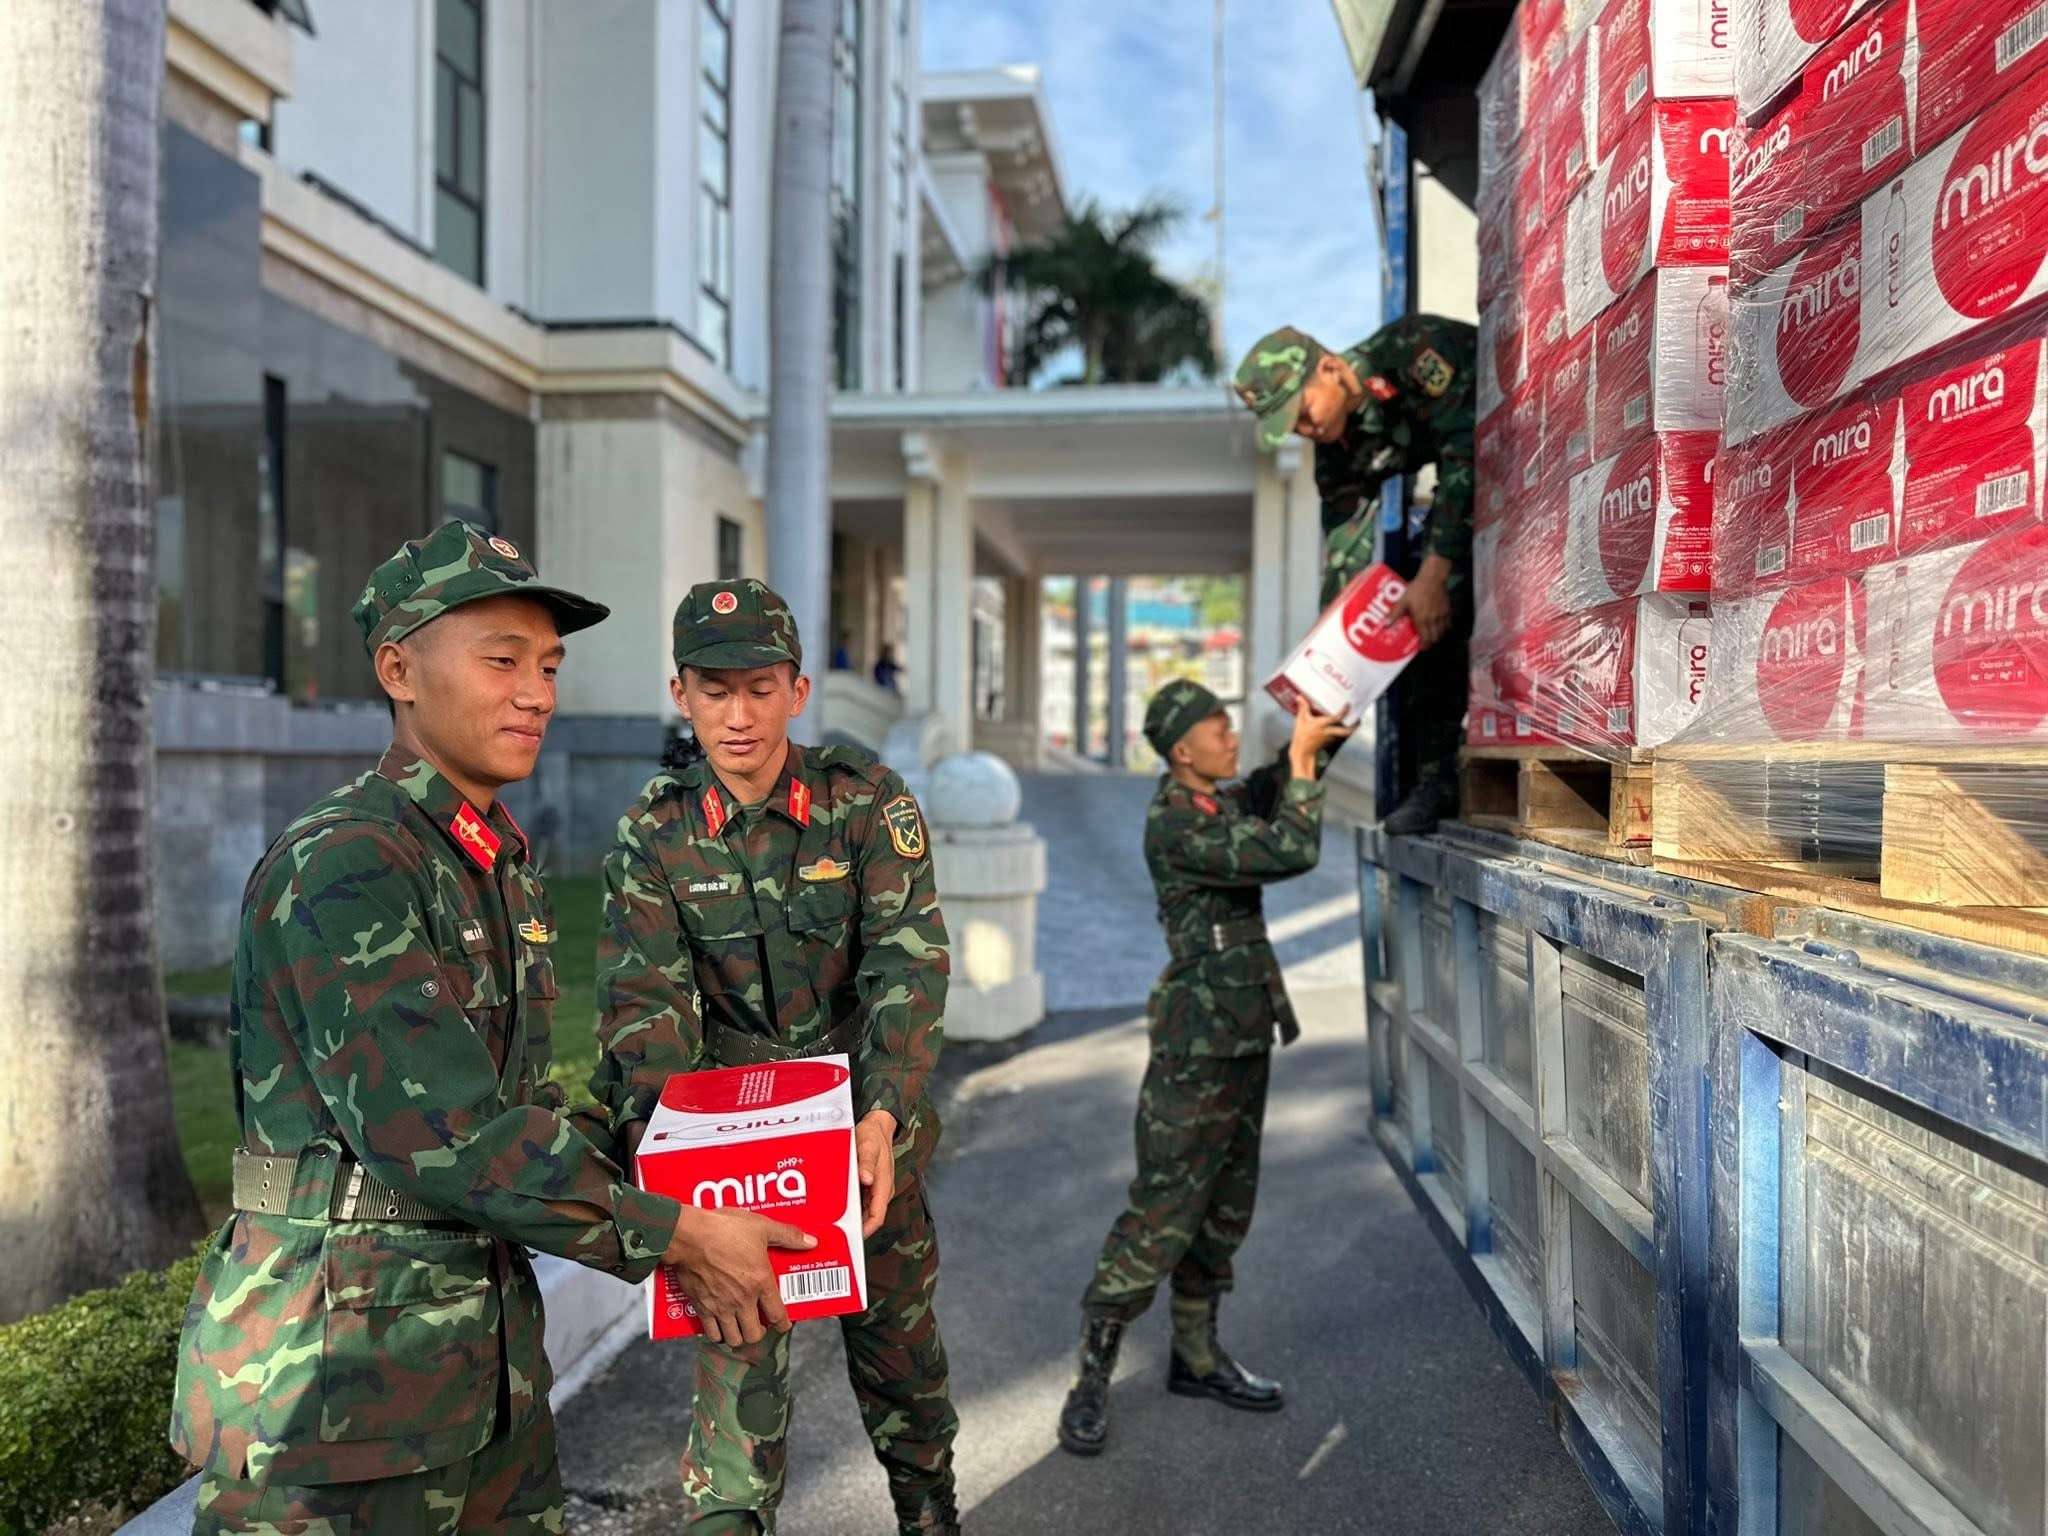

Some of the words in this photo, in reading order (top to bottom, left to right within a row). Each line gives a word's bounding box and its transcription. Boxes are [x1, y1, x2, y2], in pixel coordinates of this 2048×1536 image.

[1823, 31, 1882, 102] mira
[1744, 123, 1791, 180] mira
[1605, 155, 1648, 228] mira
[1782, 256, 1860, 333] mira
[1607, 312, 1639, 355] mira
[1708, 322, 1727, 386] mira
[1928, 367, 2004, 421] mira
[1812, 421, 1871, 466] mira
[1602, 475, 1652, 525] mira
[1729, 463, 1771, 502] mira
[1347, 580, 1407, 647] mira
[1763, 618, 1837, 663] mira
[1690, 645, 1707, 705] mira
[716, 1116, 800, 1132] mira
[692, 1169, 806, 1209] mira
[777, 1157, 804, 1171] pH9+
